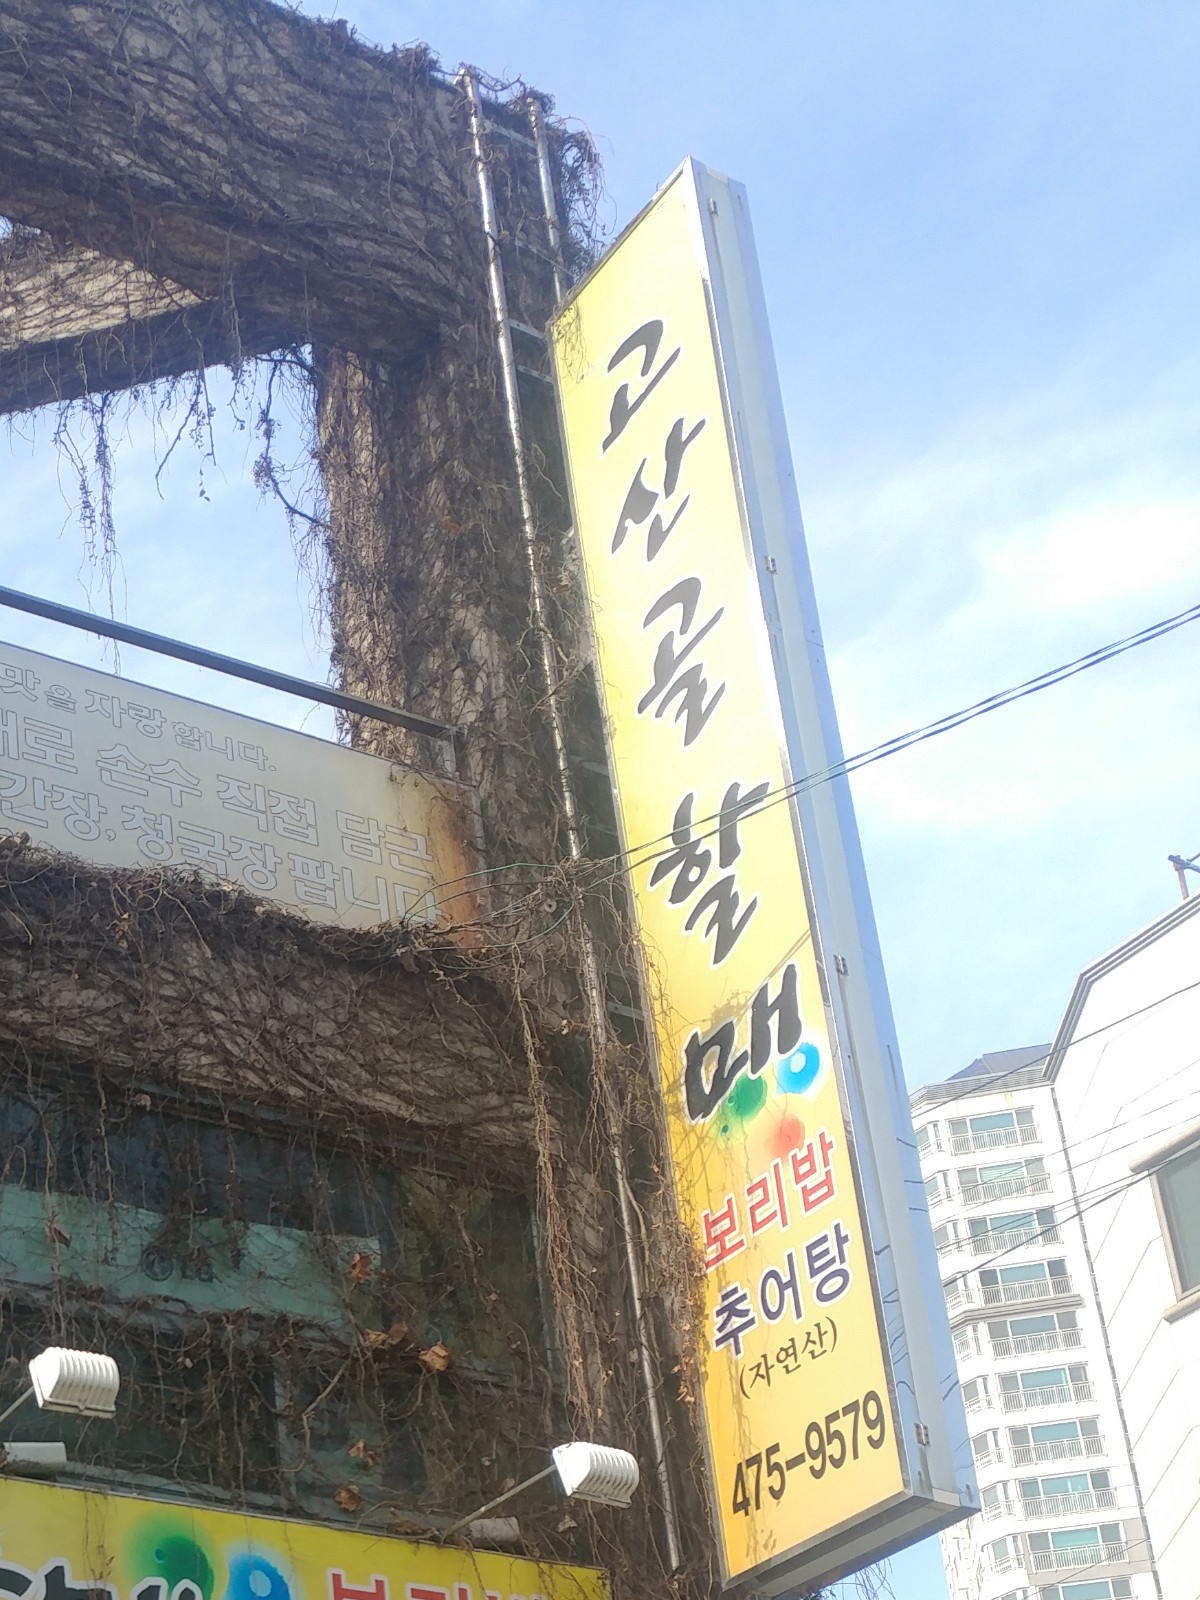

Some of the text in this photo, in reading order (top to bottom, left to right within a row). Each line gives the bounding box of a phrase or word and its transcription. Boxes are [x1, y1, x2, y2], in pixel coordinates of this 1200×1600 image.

[602, 319, 802, 1122] 고산골할매
[97, 743, 202, 807] 손수
[217, 774, 319, 846] 직접
[336, 810, 433, 878] 담근
[704, 1132, 836, 1272] 보리밥
[714, 1223, 852, 1357] 추어탕
[738, 1317, 838, 1399] (자연산)
[731, 1390, 885, 1517] 475-9579
